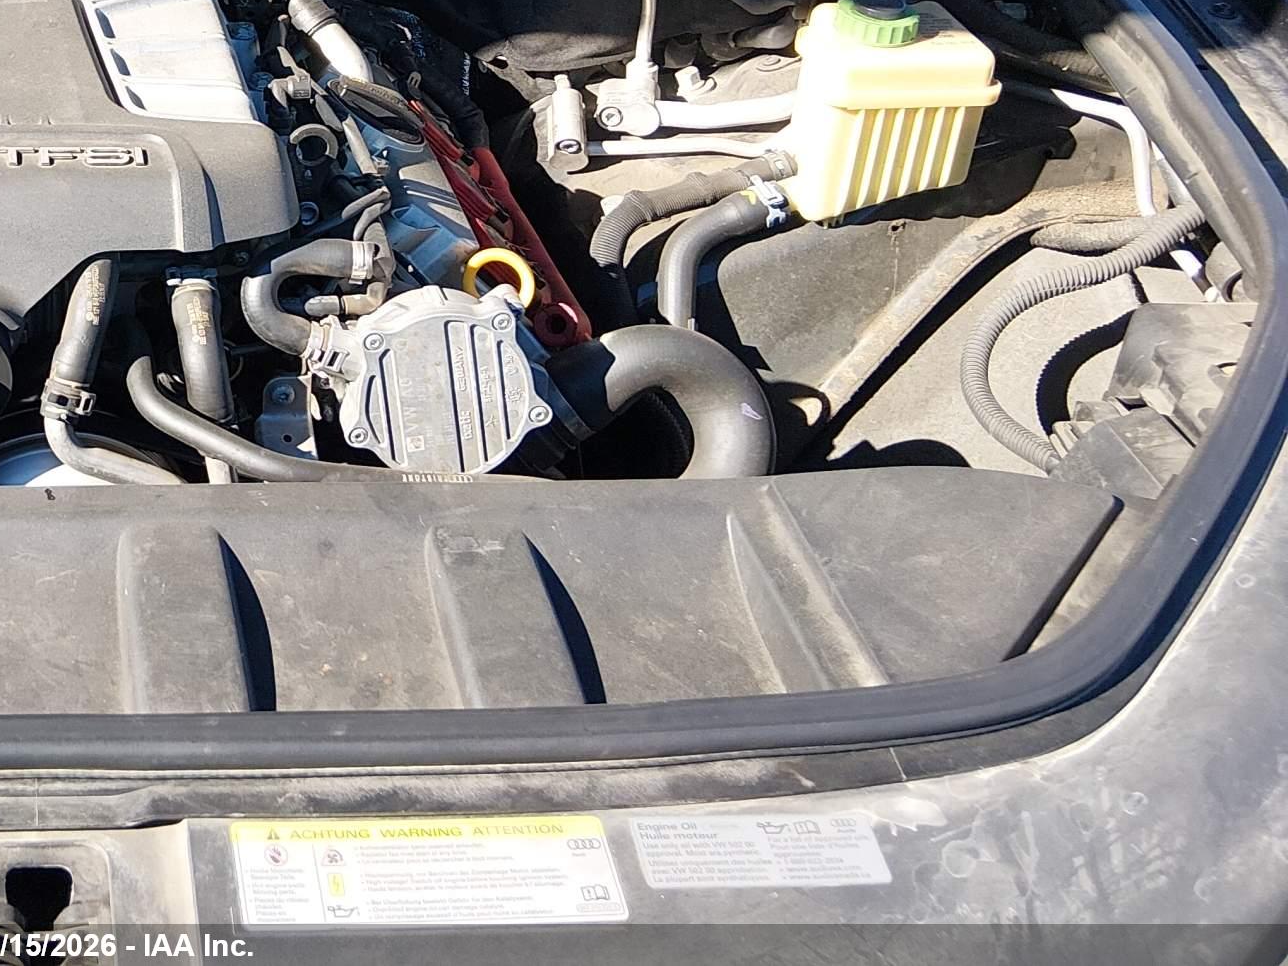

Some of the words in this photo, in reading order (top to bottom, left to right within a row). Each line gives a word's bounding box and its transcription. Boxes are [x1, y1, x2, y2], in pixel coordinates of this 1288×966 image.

[289, 829, 370, 840] ACHTUNG
[379, 826, 462, 838] WARNING
[472, 824, 564, 836] ATTENTION
[637, 822, 678, 832] Engine
[680, 821, 697, 830] Oil
[640, 832, 671, 840] Huile
[673, 832, 718, 840] moteur
